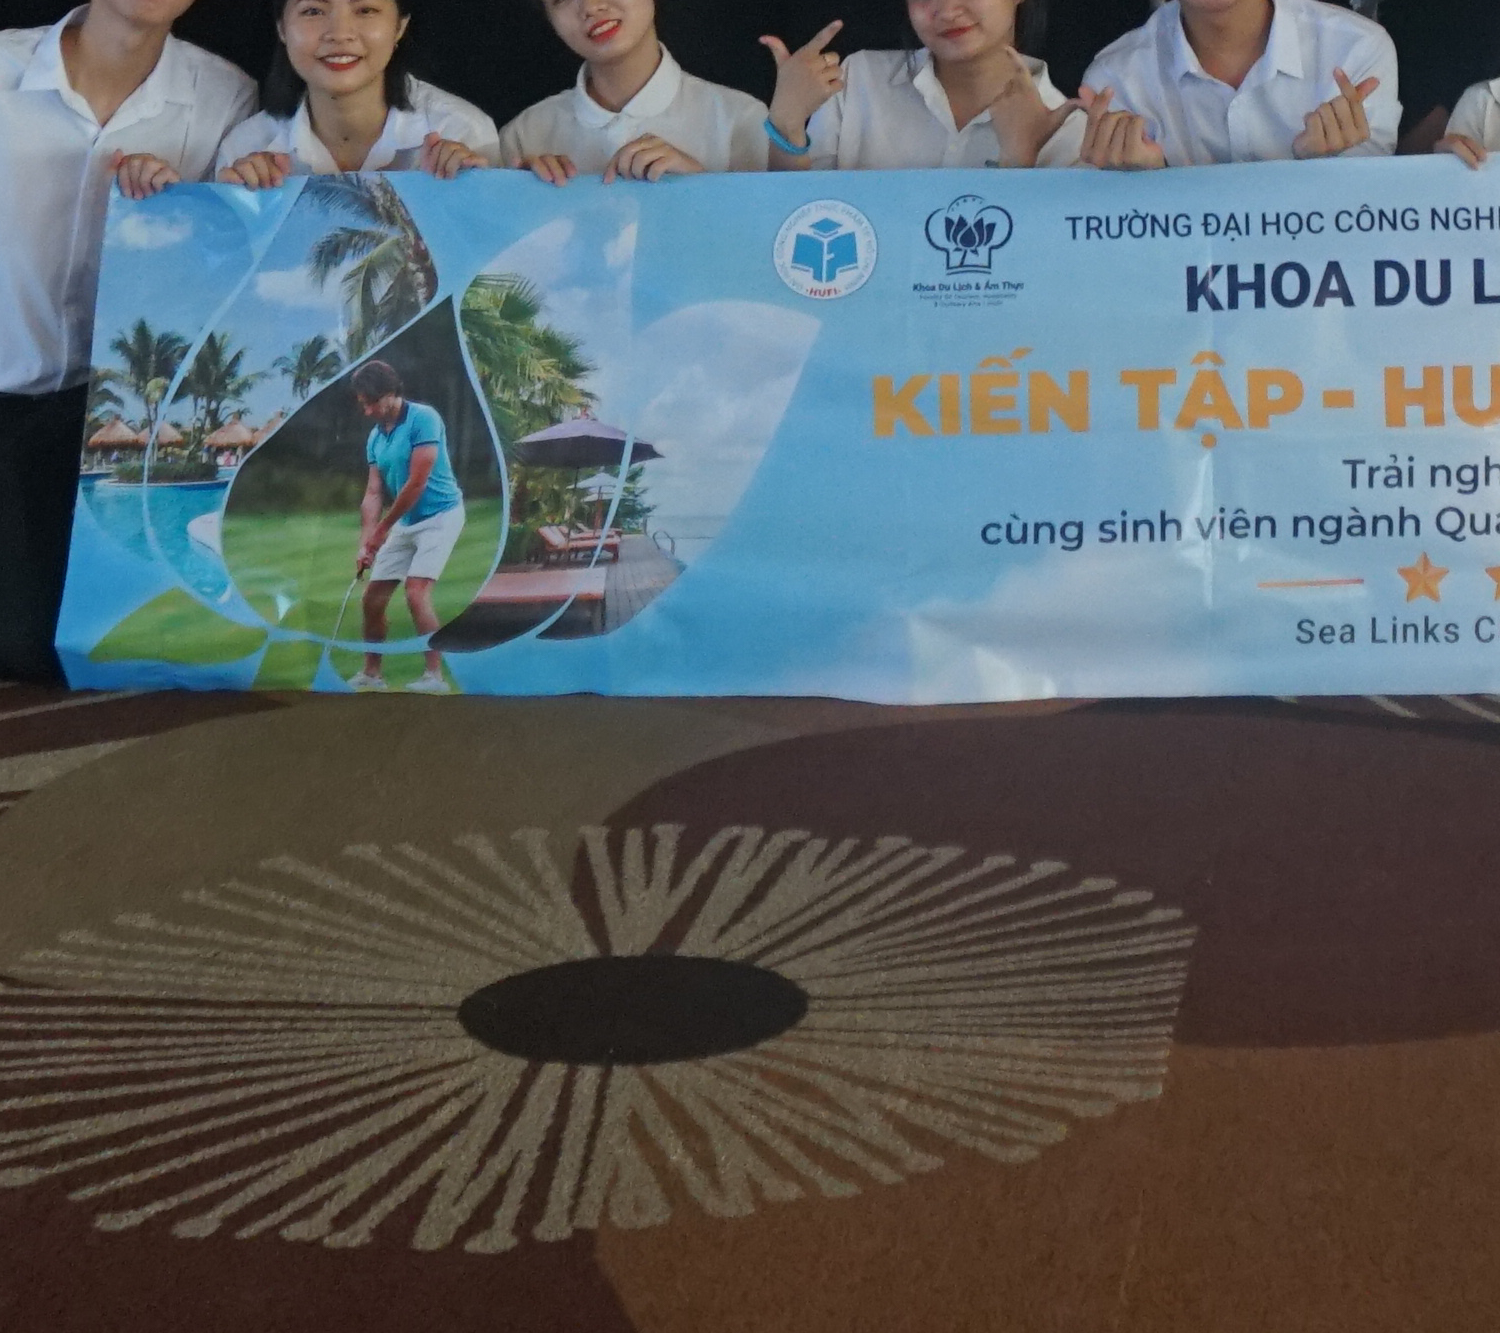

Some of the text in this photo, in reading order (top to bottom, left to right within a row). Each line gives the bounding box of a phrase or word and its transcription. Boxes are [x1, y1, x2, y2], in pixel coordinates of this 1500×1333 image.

[1065, 209, 1193, 240] TRƯỜNG
[1201, 212, 1251, 242] ĐẠI
[1261, 211, 1325, 240] HỌC
[1334, 204, 1420, 233] CÔNG
[939, 282, 950, 292] Du
[1186, 259, 1356, 313] KHOA
[1374, 259, 1452, 307] DU
[872, 347, 1090, 438] KIẾN
[1120, 350, 1305, 449] TẬP
[1342, 454, 1415, 489] Trải
[980, 512, 1084, 552] cùng
[1098, 509, 1182, 544] sinh
[1195, 506, 1277, 541] viên
[1292, 506, 1421, 545] ngành
[1296, 617, 1356, 644] Sea
[1370, 616, 1461, 644] Links
